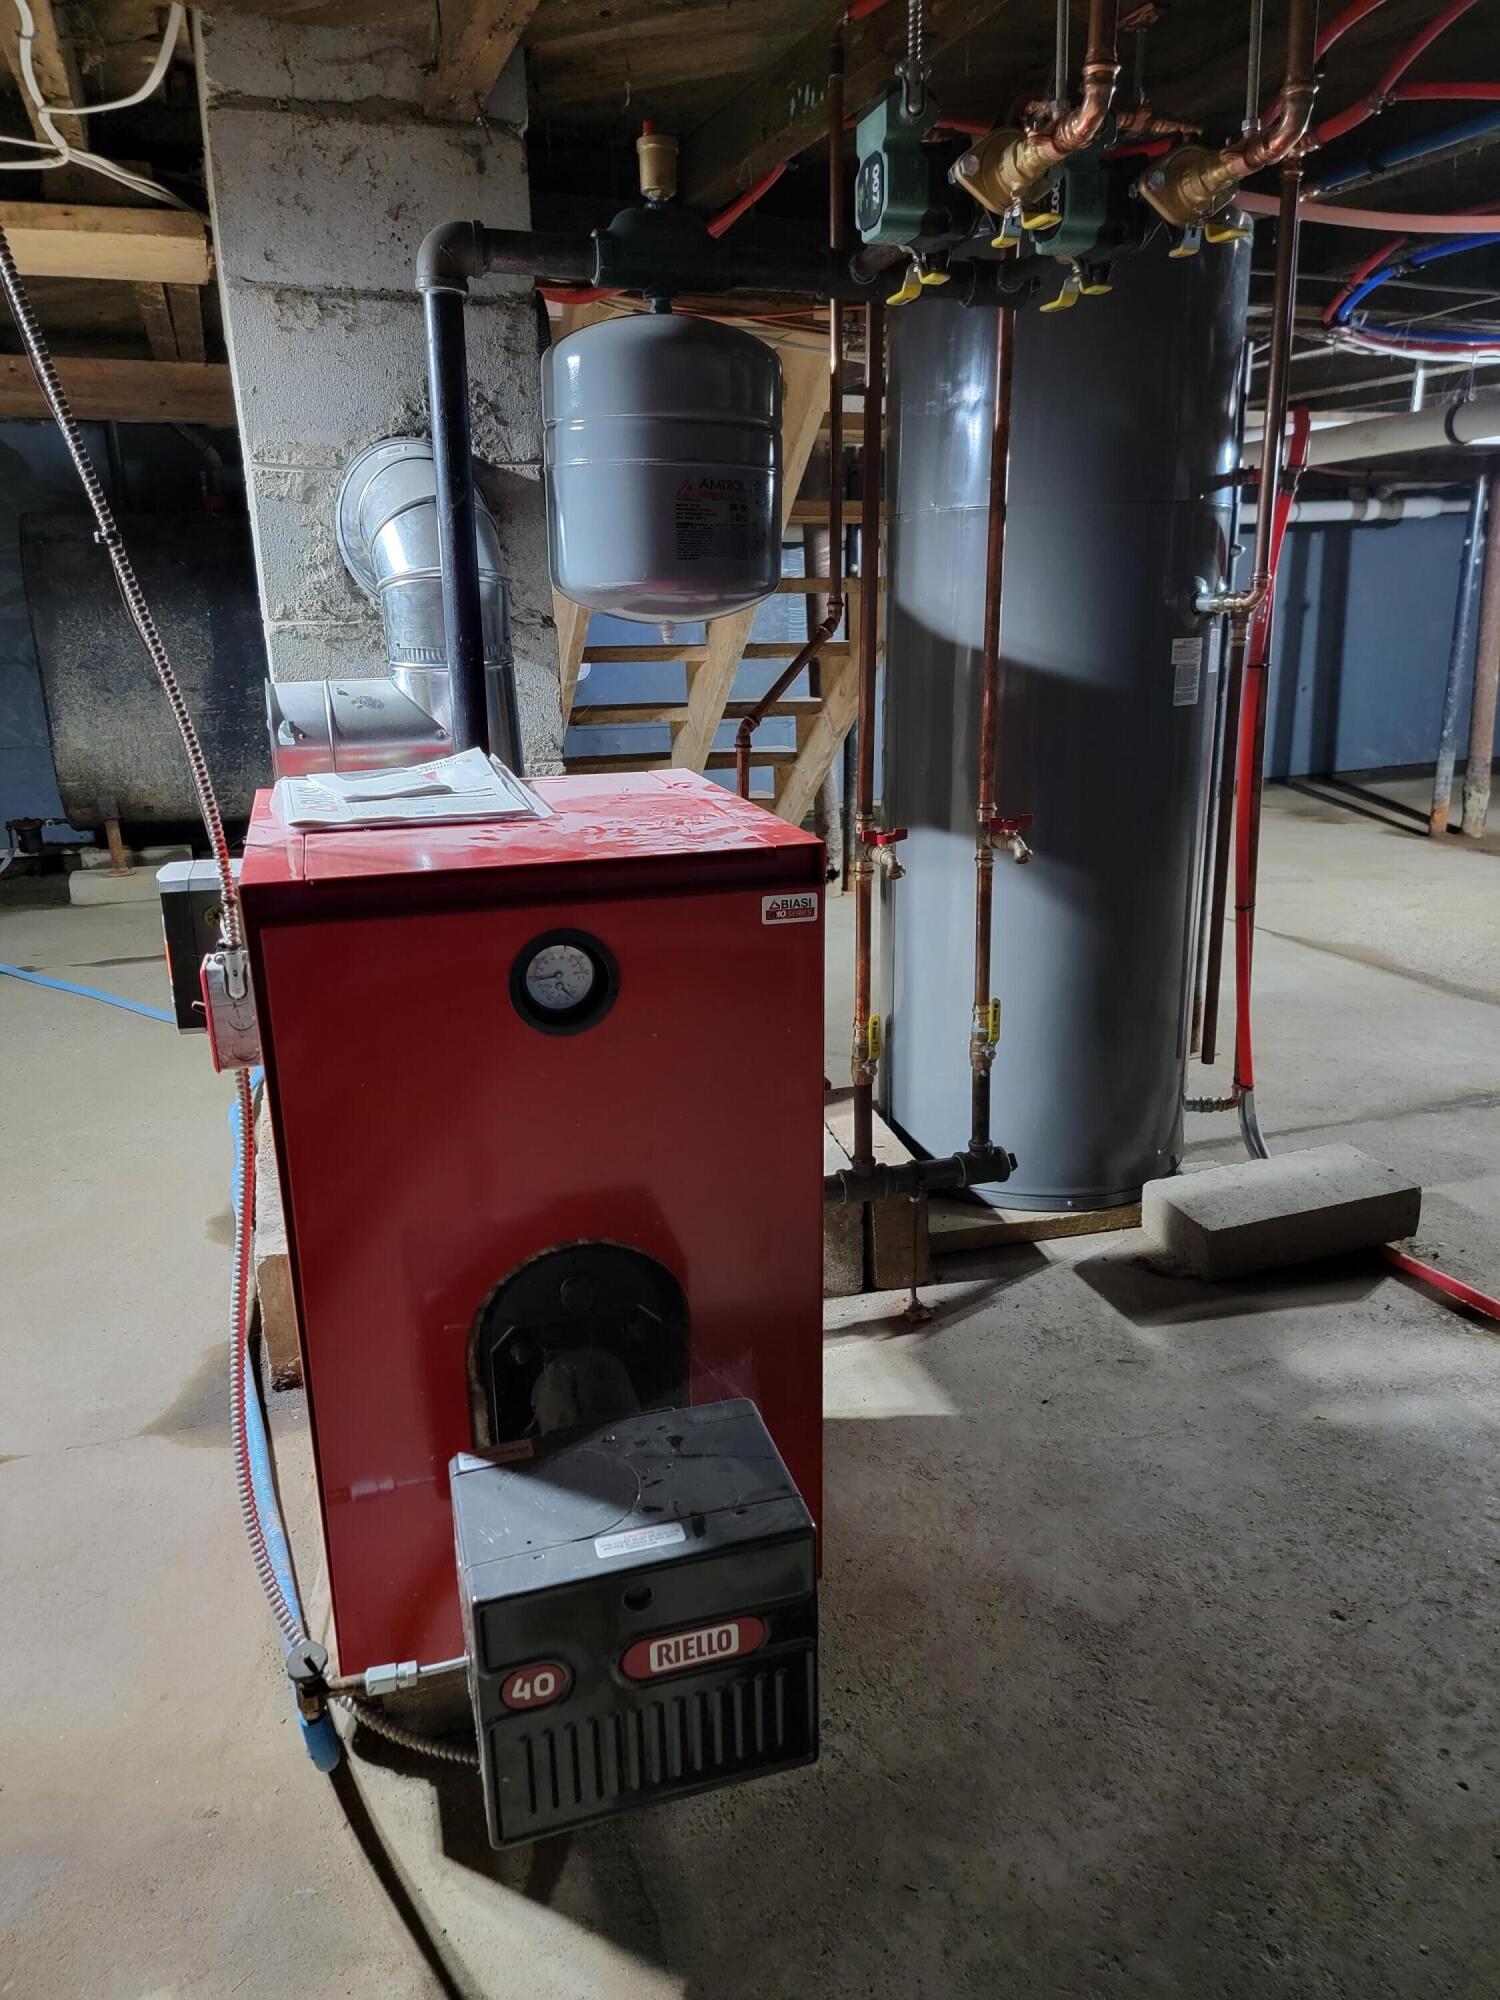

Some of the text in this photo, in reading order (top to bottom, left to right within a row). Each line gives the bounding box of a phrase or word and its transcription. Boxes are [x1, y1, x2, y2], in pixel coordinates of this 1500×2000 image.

[781, 898, 811, 908] BIASI
[656, 1629, 733, 1667] RIELLO
[511, 1671, 555, 1700] 40
